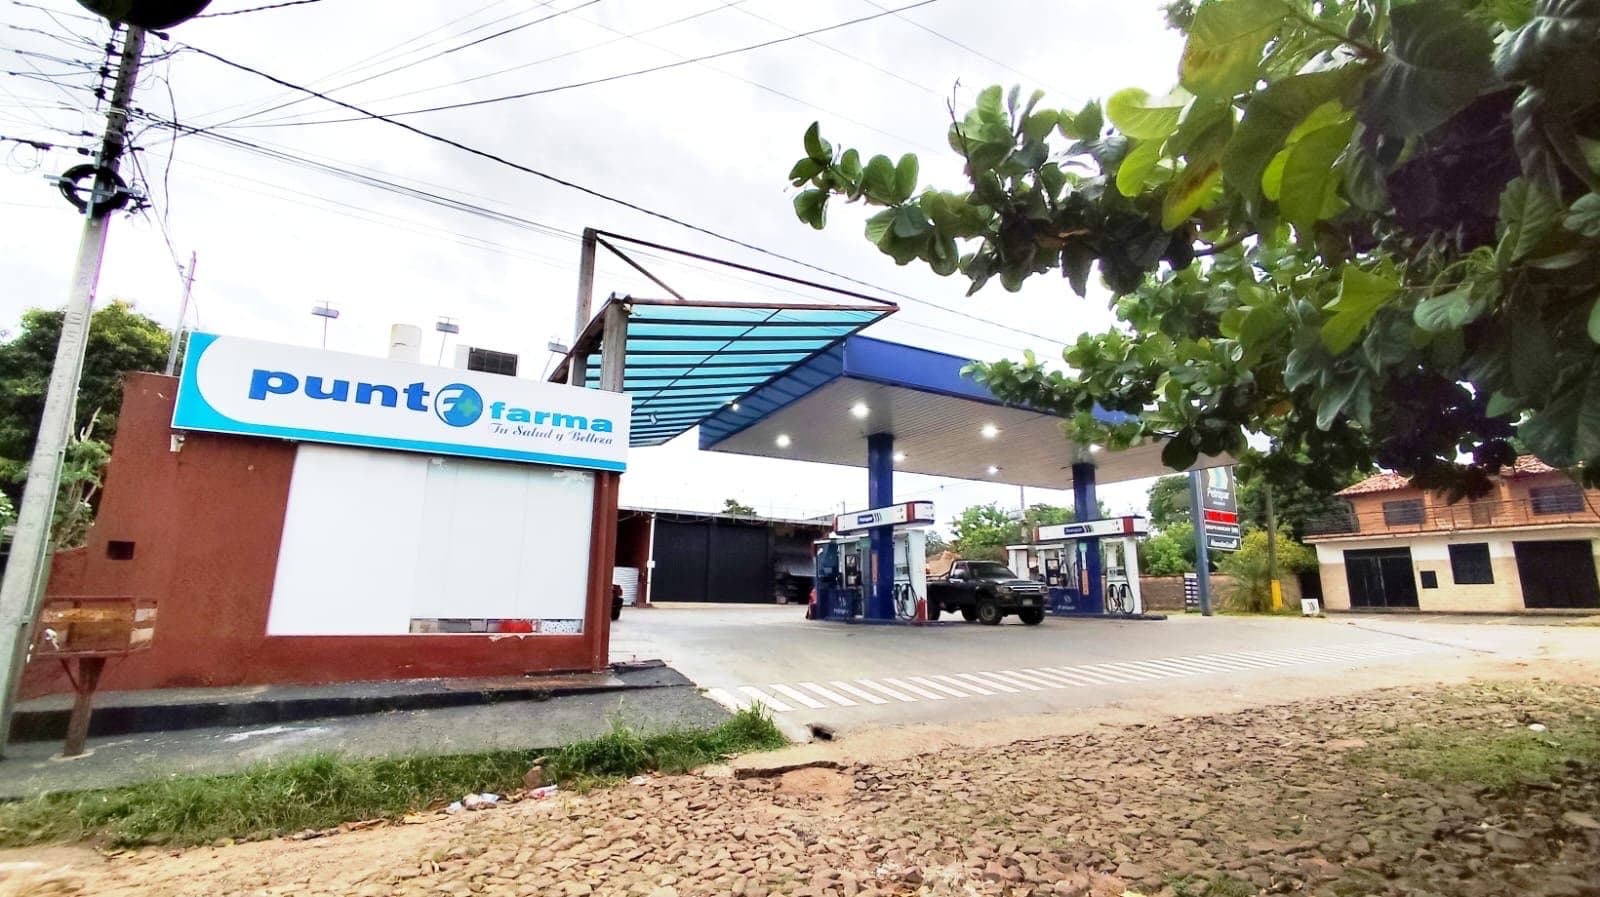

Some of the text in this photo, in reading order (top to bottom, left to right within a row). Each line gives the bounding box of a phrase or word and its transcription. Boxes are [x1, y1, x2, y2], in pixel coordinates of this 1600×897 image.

[489, 401, 613, 433] farma
[513, 425, 553, 440] Salud
[556, 432, 564, 442] y
[569, 431, 613, 445] Belleza
